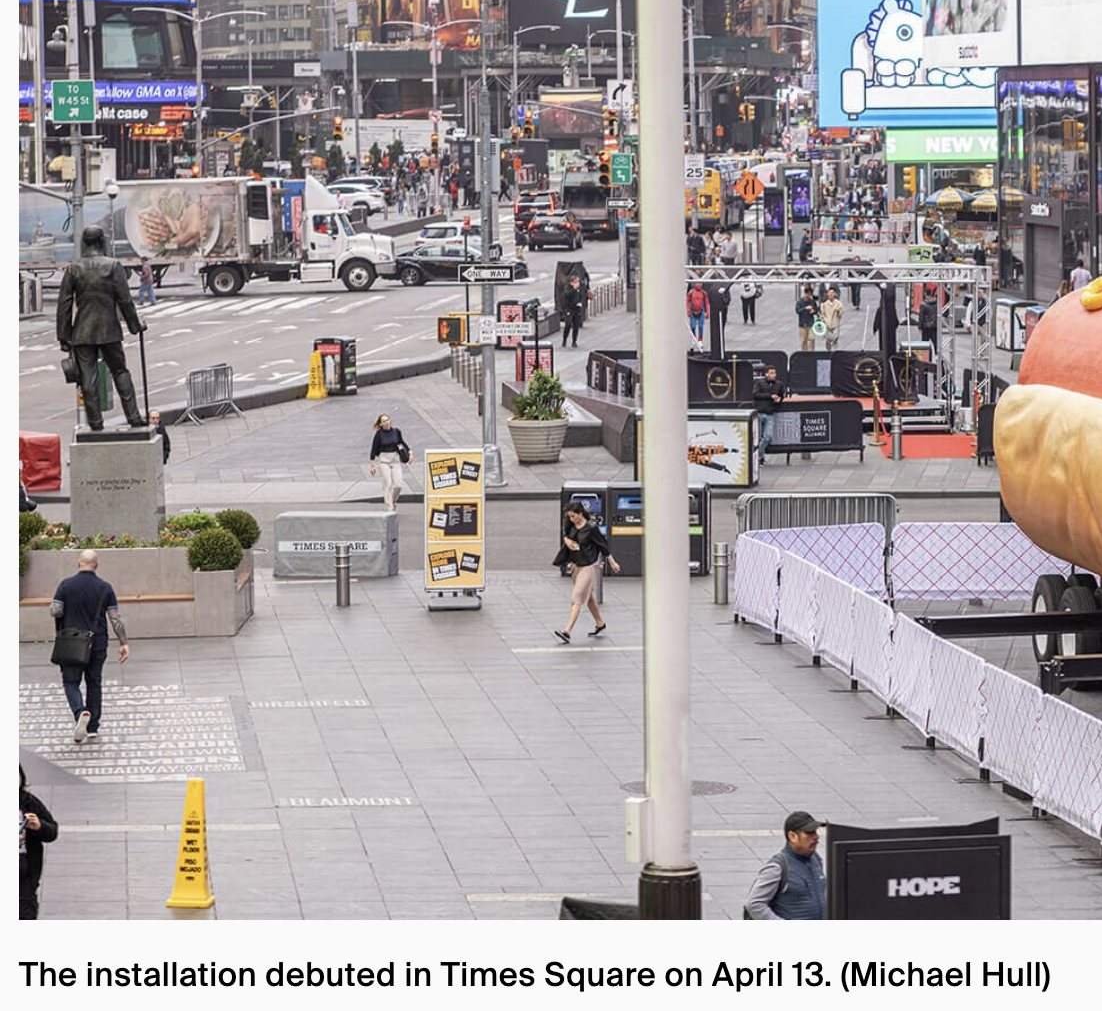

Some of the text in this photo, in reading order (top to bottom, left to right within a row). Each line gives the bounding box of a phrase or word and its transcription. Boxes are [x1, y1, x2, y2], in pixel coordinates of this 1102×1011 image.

[67, 85, 79, 93] TO
[58, 96, 89, 104] W 45 St
[925, 137, 975, 153] NEW
[687, 169, 702, 177] 25
[490, 269, 507, 277] WAY
[293, 542, 368, 550] TIMES SARE
[290, 796, 413, 807] BEAUMONT
[888, 876, 960, 897] HOPE
